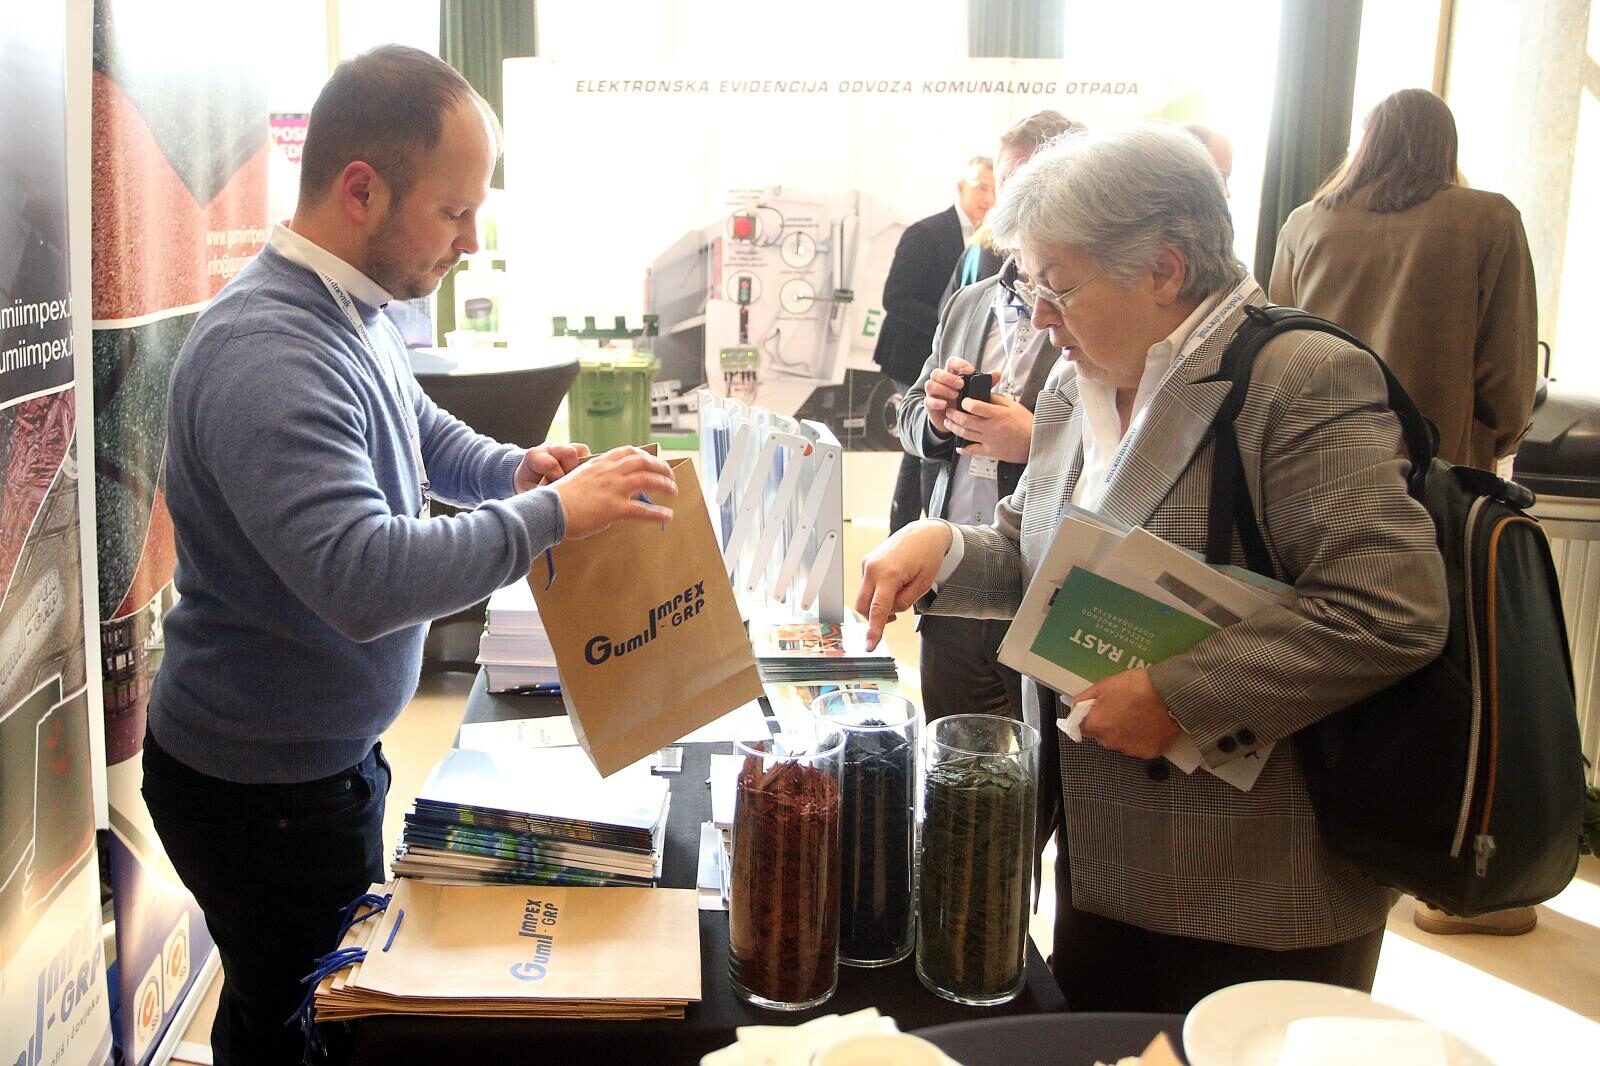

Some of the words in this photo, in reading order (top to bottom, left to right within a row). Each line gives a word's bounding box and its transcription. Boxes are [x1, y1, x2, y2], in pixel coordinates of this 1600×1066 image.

[576, 80, 709, 92] ELEKTRONSKA
[719, 80, 828, 93] EVIDENCIJA
[838, 81, 912, 93] ODVOZA
[922, 81, 1056, 94] KOMUNALNOG
[1065, 82, 1138, 95] OTPADA
[0, 291, 72, 329] miimpex.
[1069, 628, 1124, 663] RAST
